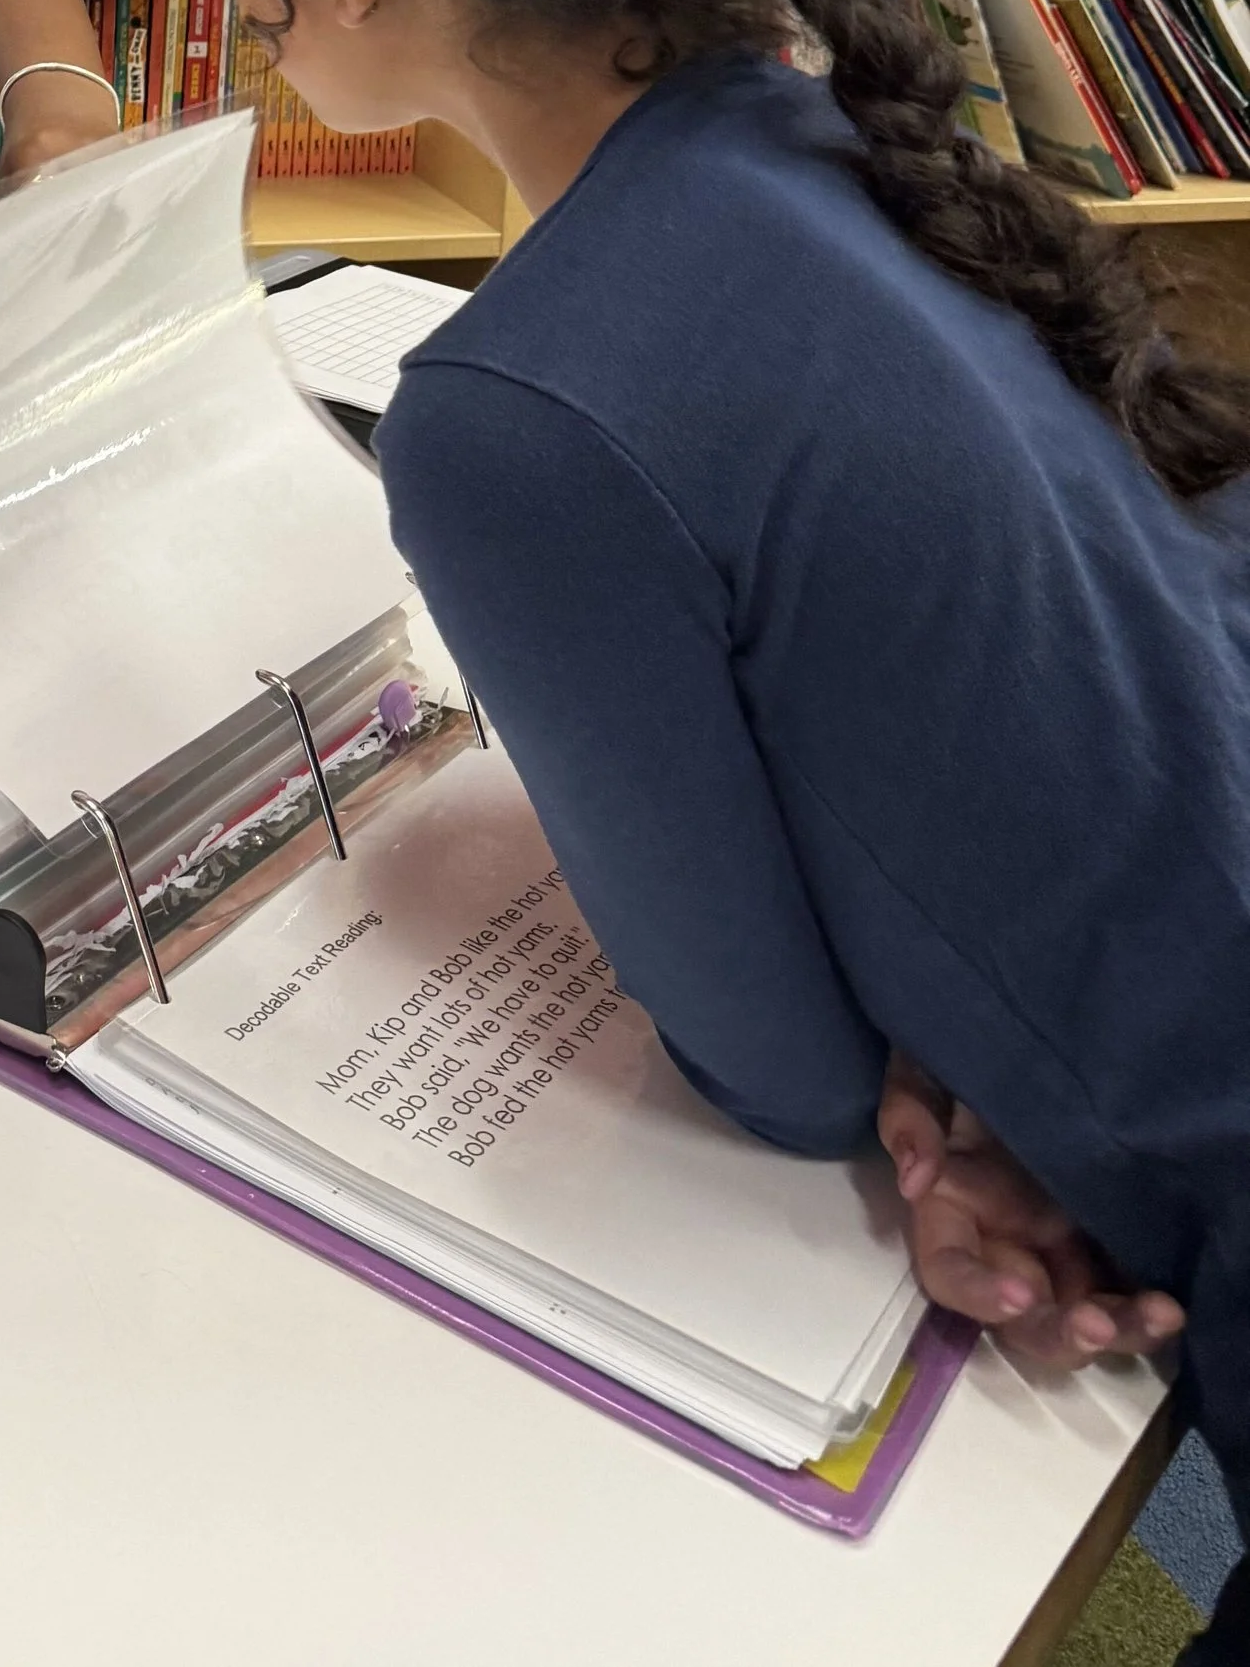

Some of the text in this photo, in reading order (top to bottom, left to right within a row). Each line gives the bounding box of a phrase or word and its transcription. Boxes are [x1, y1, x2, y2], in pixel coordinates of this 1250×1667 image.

[224, 910, 382, 1040] Decodable Text Reading:
[315, 884, 547, 1094] Mom, Kip and Bob like the hot
[345, 922, 558, 1110] They want lots of hot yams.
[379, 926, 589, 1130] Bob said, "We have to quit."
[412, 974, 591, 1147] The dog wants the hot
[447, 998, 617, 1166] Bob fed the hot yams
